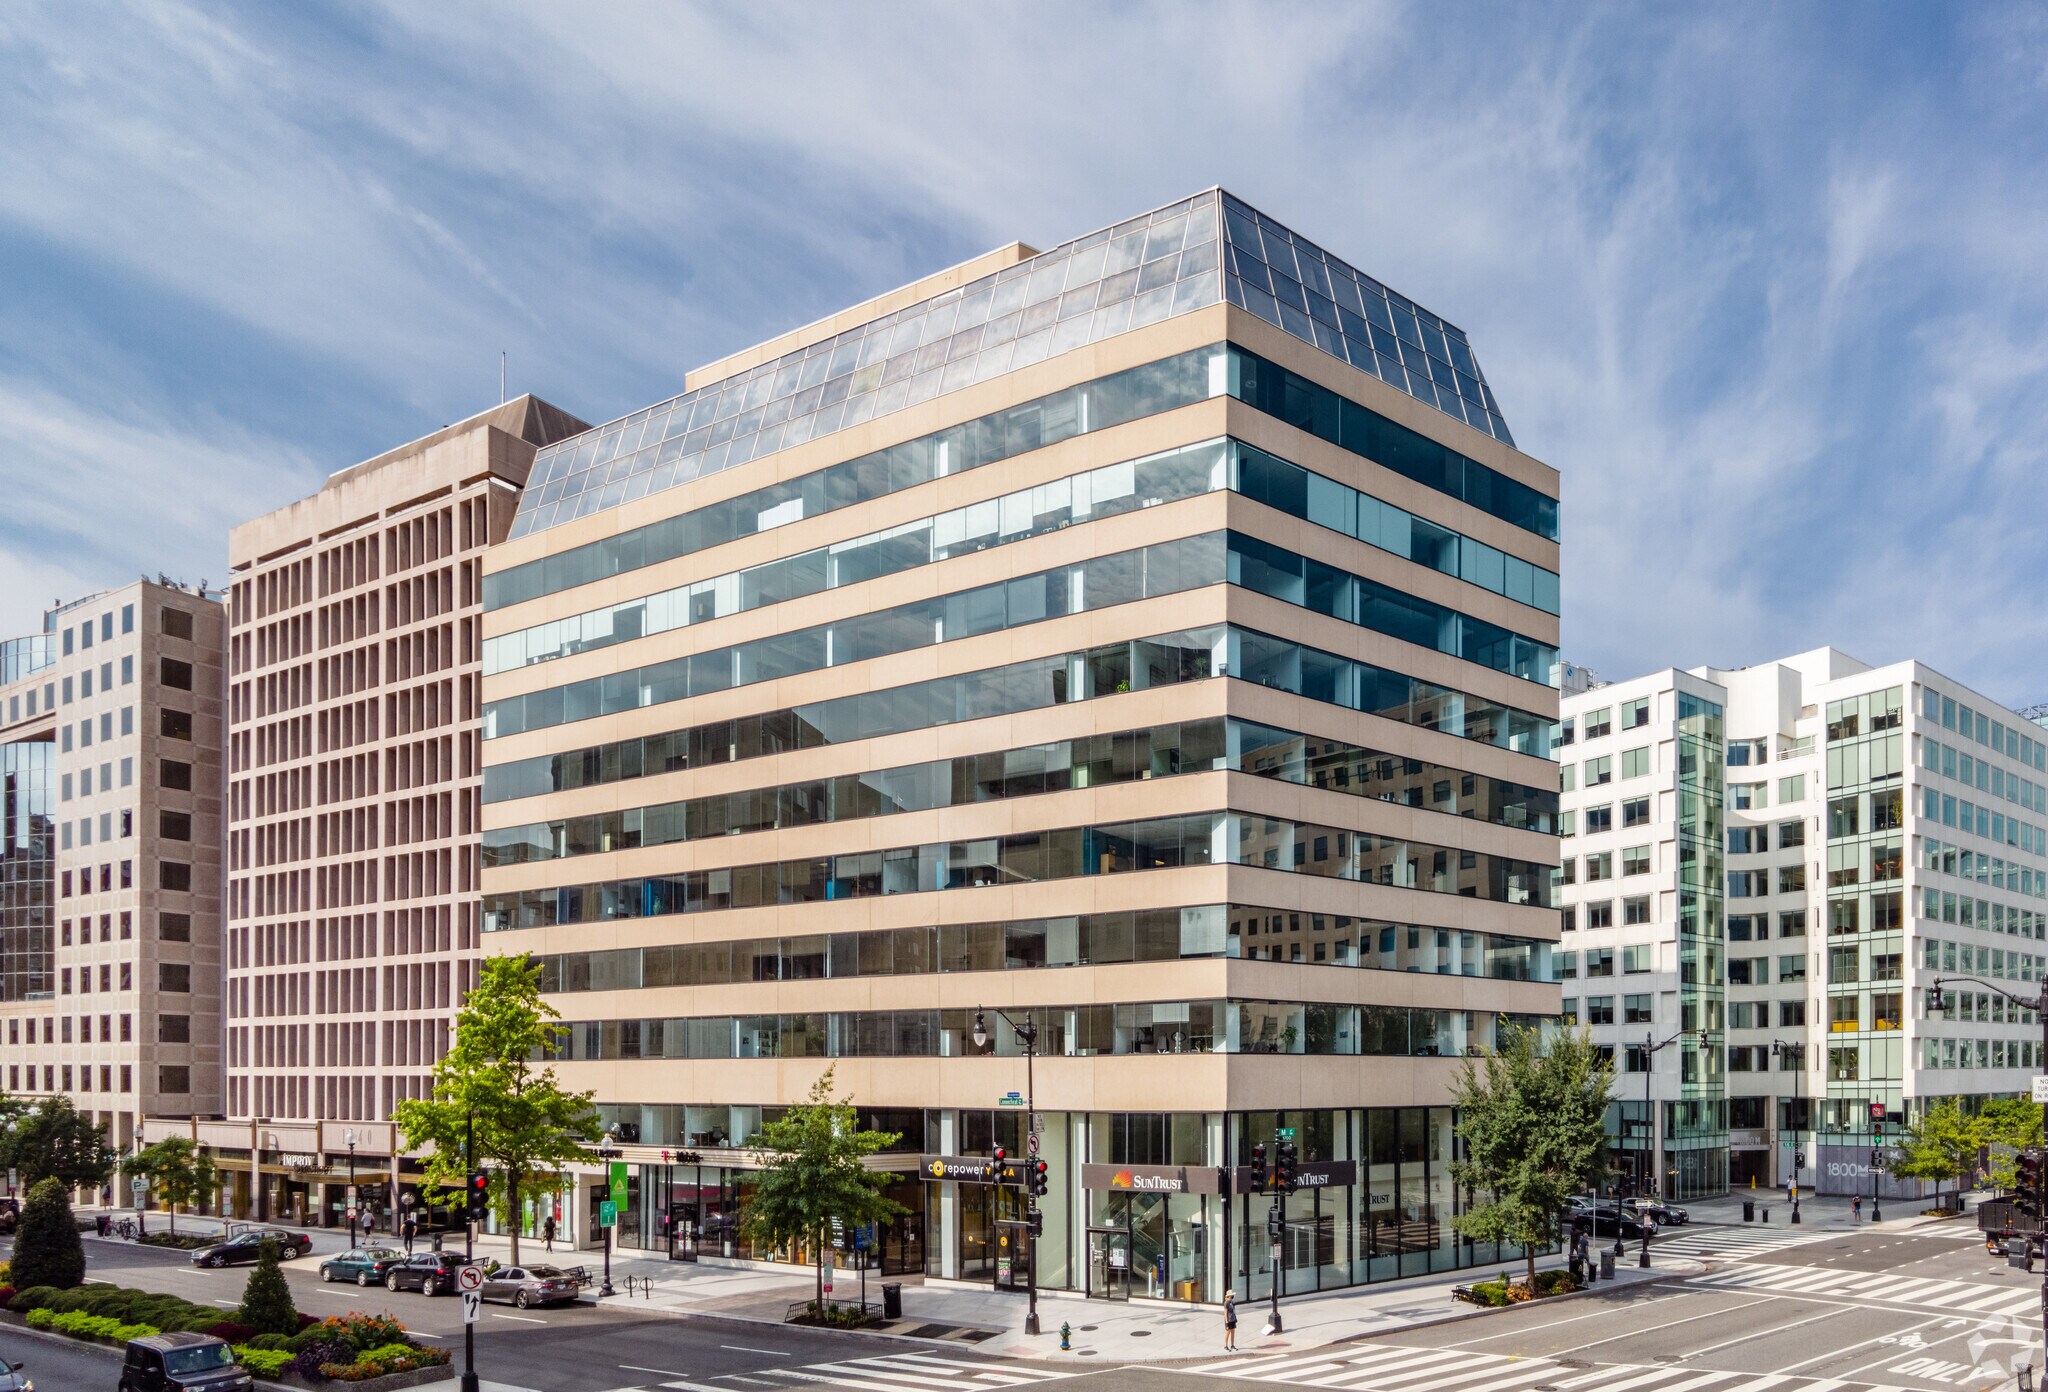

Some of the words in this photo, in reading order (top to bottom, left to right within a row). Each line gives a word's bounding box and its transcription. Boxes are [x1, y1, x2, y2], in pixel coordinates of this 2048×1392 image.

[928, 1160, 984, 1177] corepower
[986, 1167, 1015, 1177] YA
[1887, 1357, 2000, 1385] ONLY
